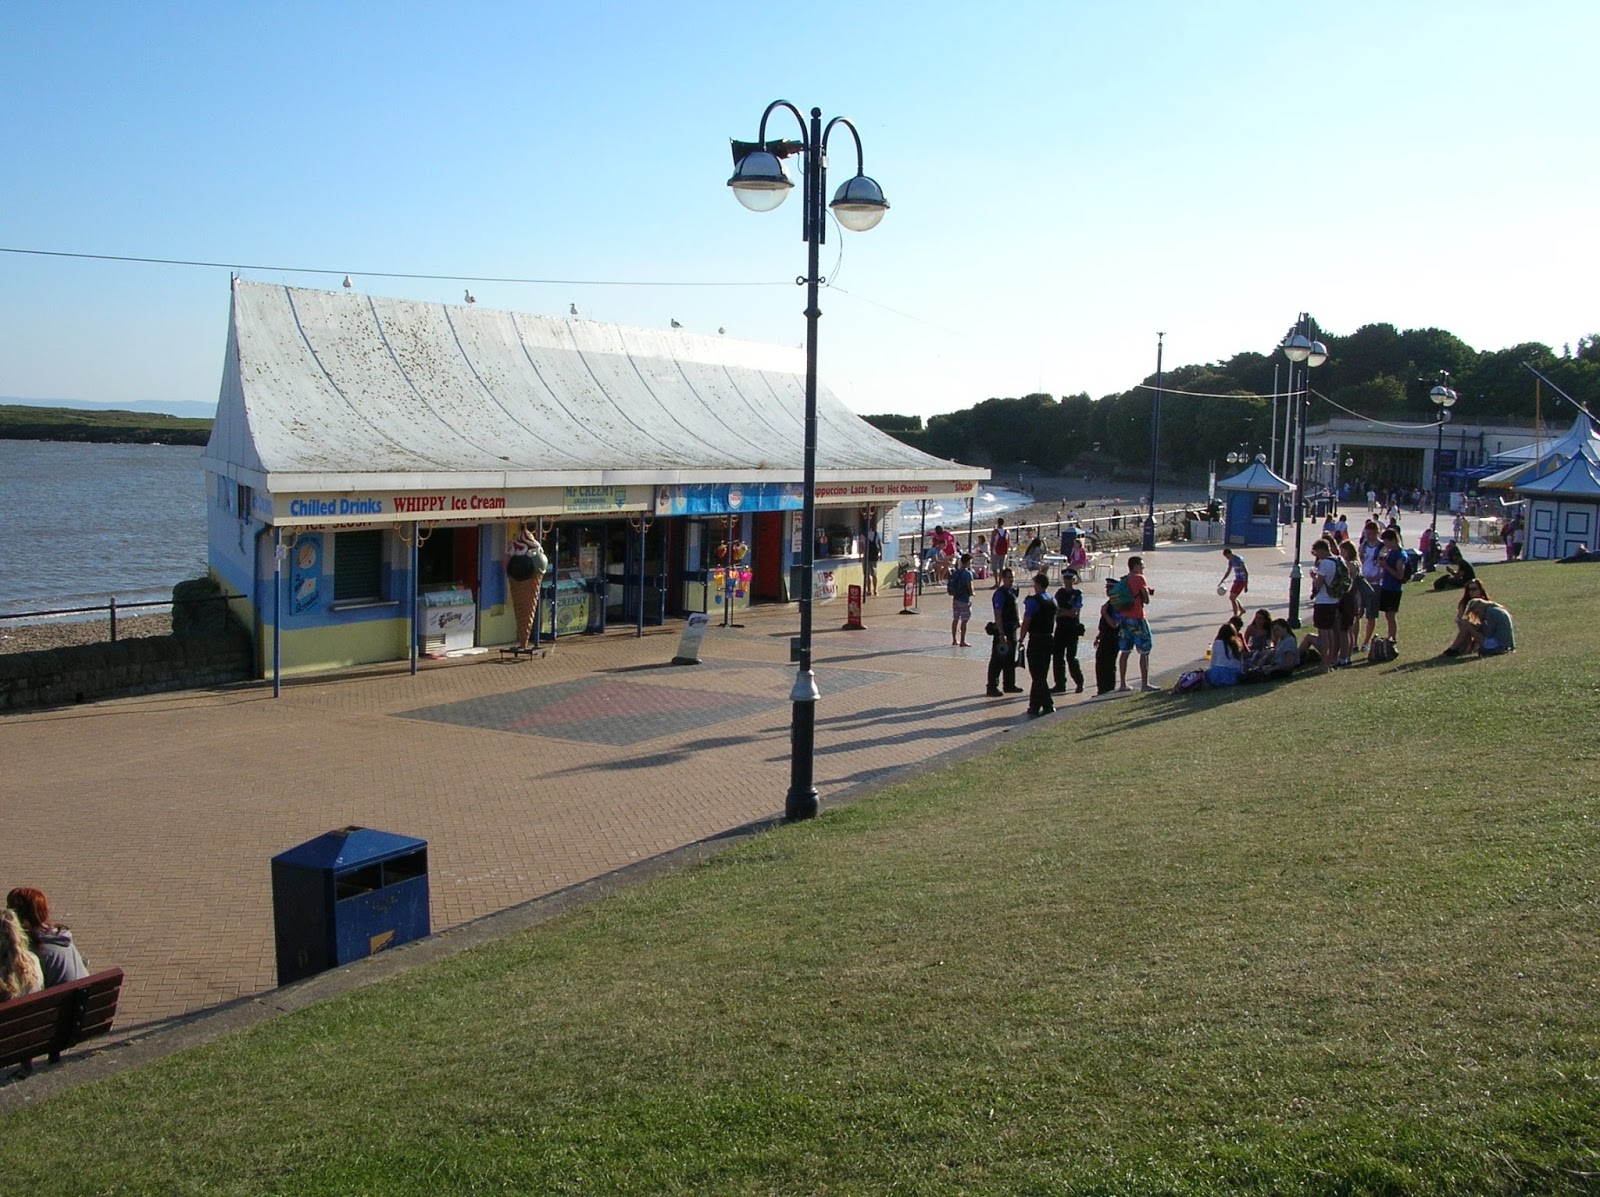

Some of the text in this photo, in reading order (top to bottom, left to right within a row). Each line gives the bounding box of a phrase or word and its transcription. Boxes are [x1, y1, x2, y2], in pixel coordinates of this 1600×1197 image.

[815, 484, 929, 498] ppuccino Latte Teas Hot Chocolate
[954, 481, 973, 491] slush
[290, 498, 382, 516] Chilled Drinks
[394, 495, 506, 512] WHIPPY Ice Cream
